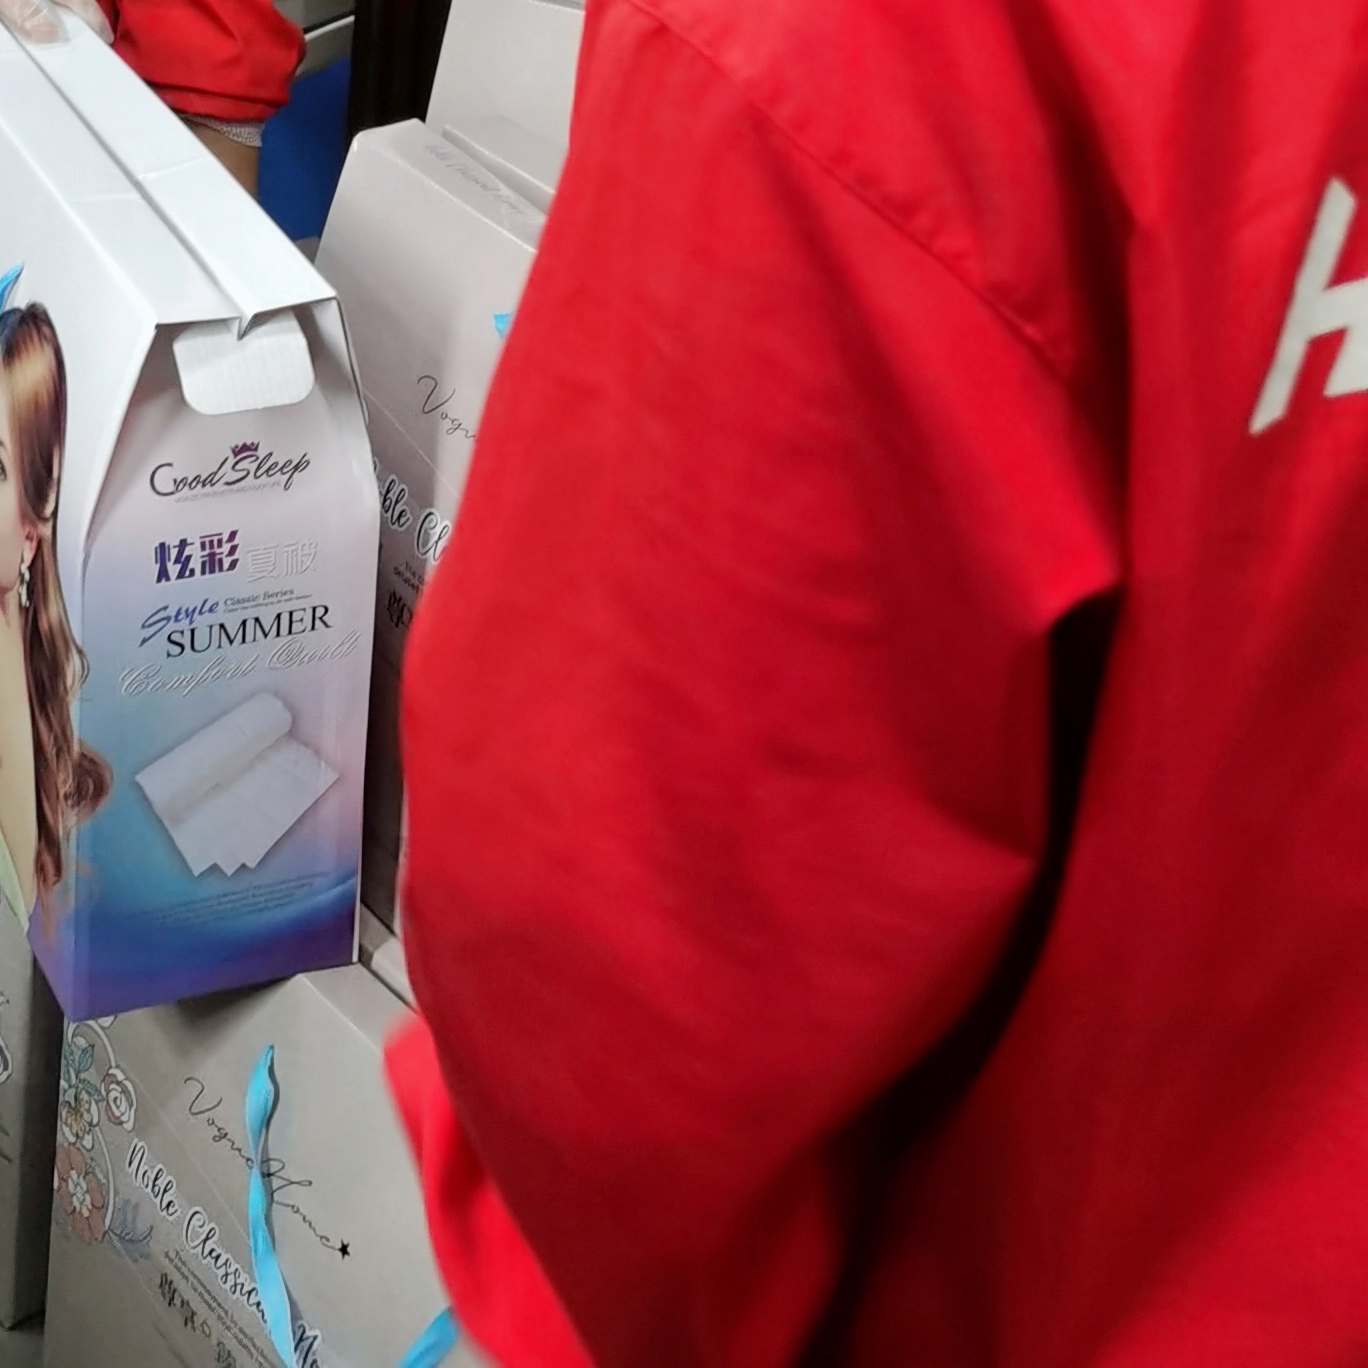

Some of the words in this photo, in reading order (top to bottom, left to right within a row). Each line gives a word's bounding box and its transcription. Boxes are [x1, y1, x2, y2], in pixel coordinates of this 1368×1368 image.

[139, 597, 220, 649] Style
[165, 603, 334, 660] SUMMER
[127, 1138, 179, 1222] Noble
